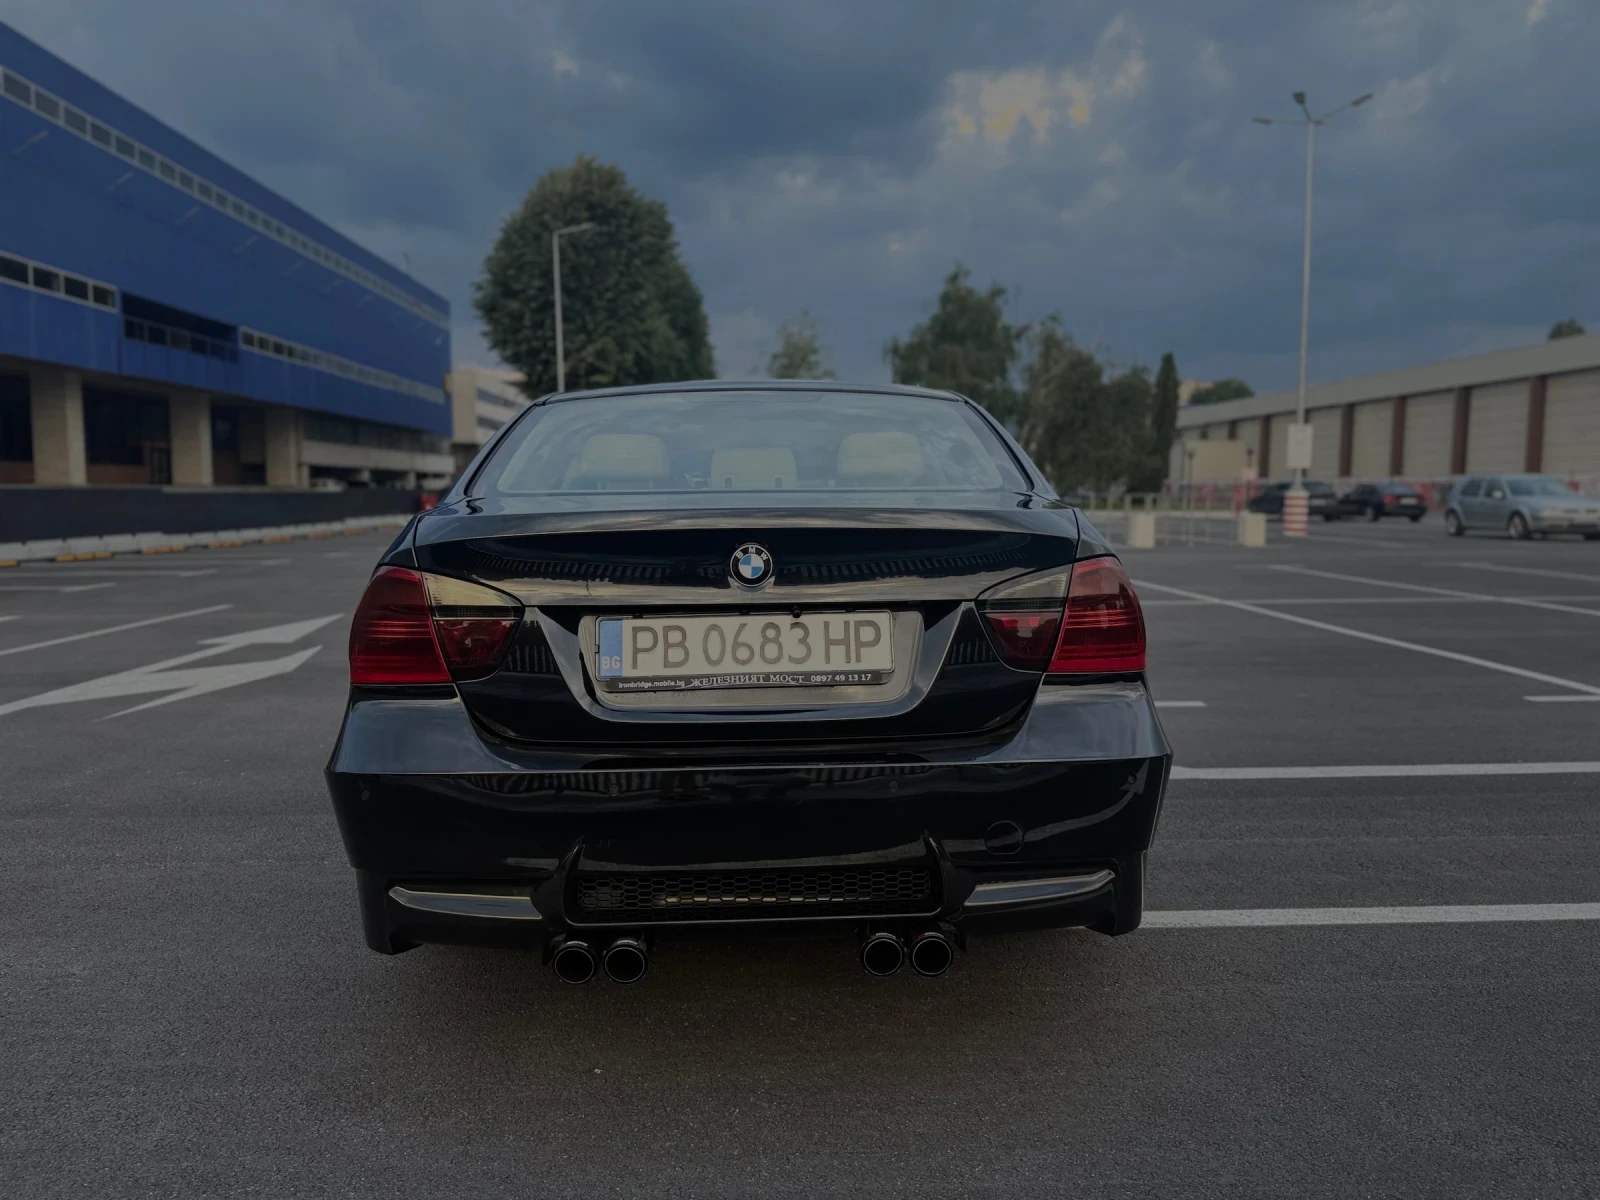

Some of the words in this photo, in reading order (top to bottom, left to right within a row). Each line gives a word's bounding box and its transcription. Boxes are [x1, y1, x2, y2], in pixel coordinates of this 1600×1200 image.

[735, 547, 768, 560] BMW
[631, 625, 690, 669] PB
[702, 622, 812, 666] 0683
[823, 620, 881, 664] HP
[601, 656, 621, 669] BG
[618, 679, 685, 689] ironbridge.mobile.bg
[690, 674, 765, 687] ЖЕЛЕЗНИЯТ
[769, 674, 804, 684] МОСТ
[810, 674, 833, 683] 0897
[834, 674, 846, 682] 49
[848, 674, 858, 682] 13
[860, 673, 872, 682] 17
